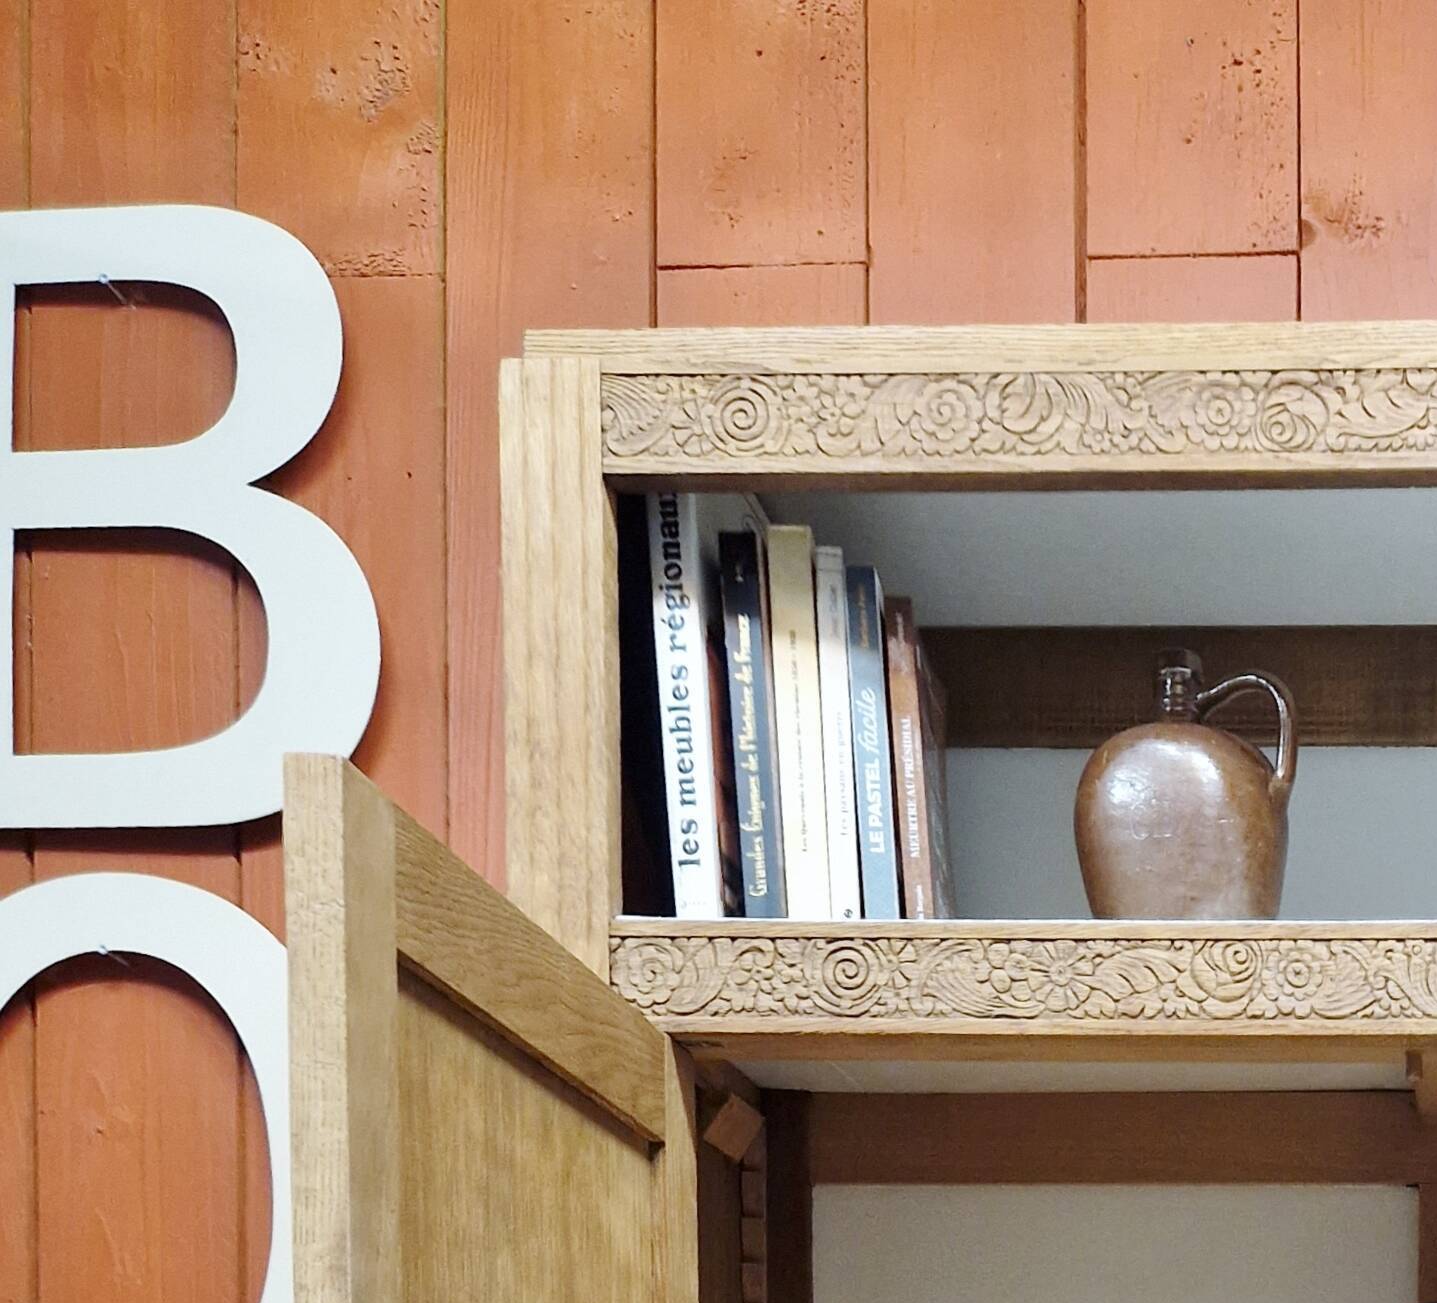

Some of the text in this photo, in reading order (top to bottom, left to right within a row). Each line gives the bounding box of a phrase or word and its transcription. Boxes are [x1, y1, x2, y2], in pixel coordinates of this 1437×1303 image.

[668, 663, 697, 807] meubles
[741, 751, 760, 774] de
[855, 687, 885, 854] LE PASTEL facile
[905, 780, 917, 798] AU
[678, 818, 701, 869] les
[906, 800, 921, 859] MEURTRE
[745, 836, 769, 897] Grandes
